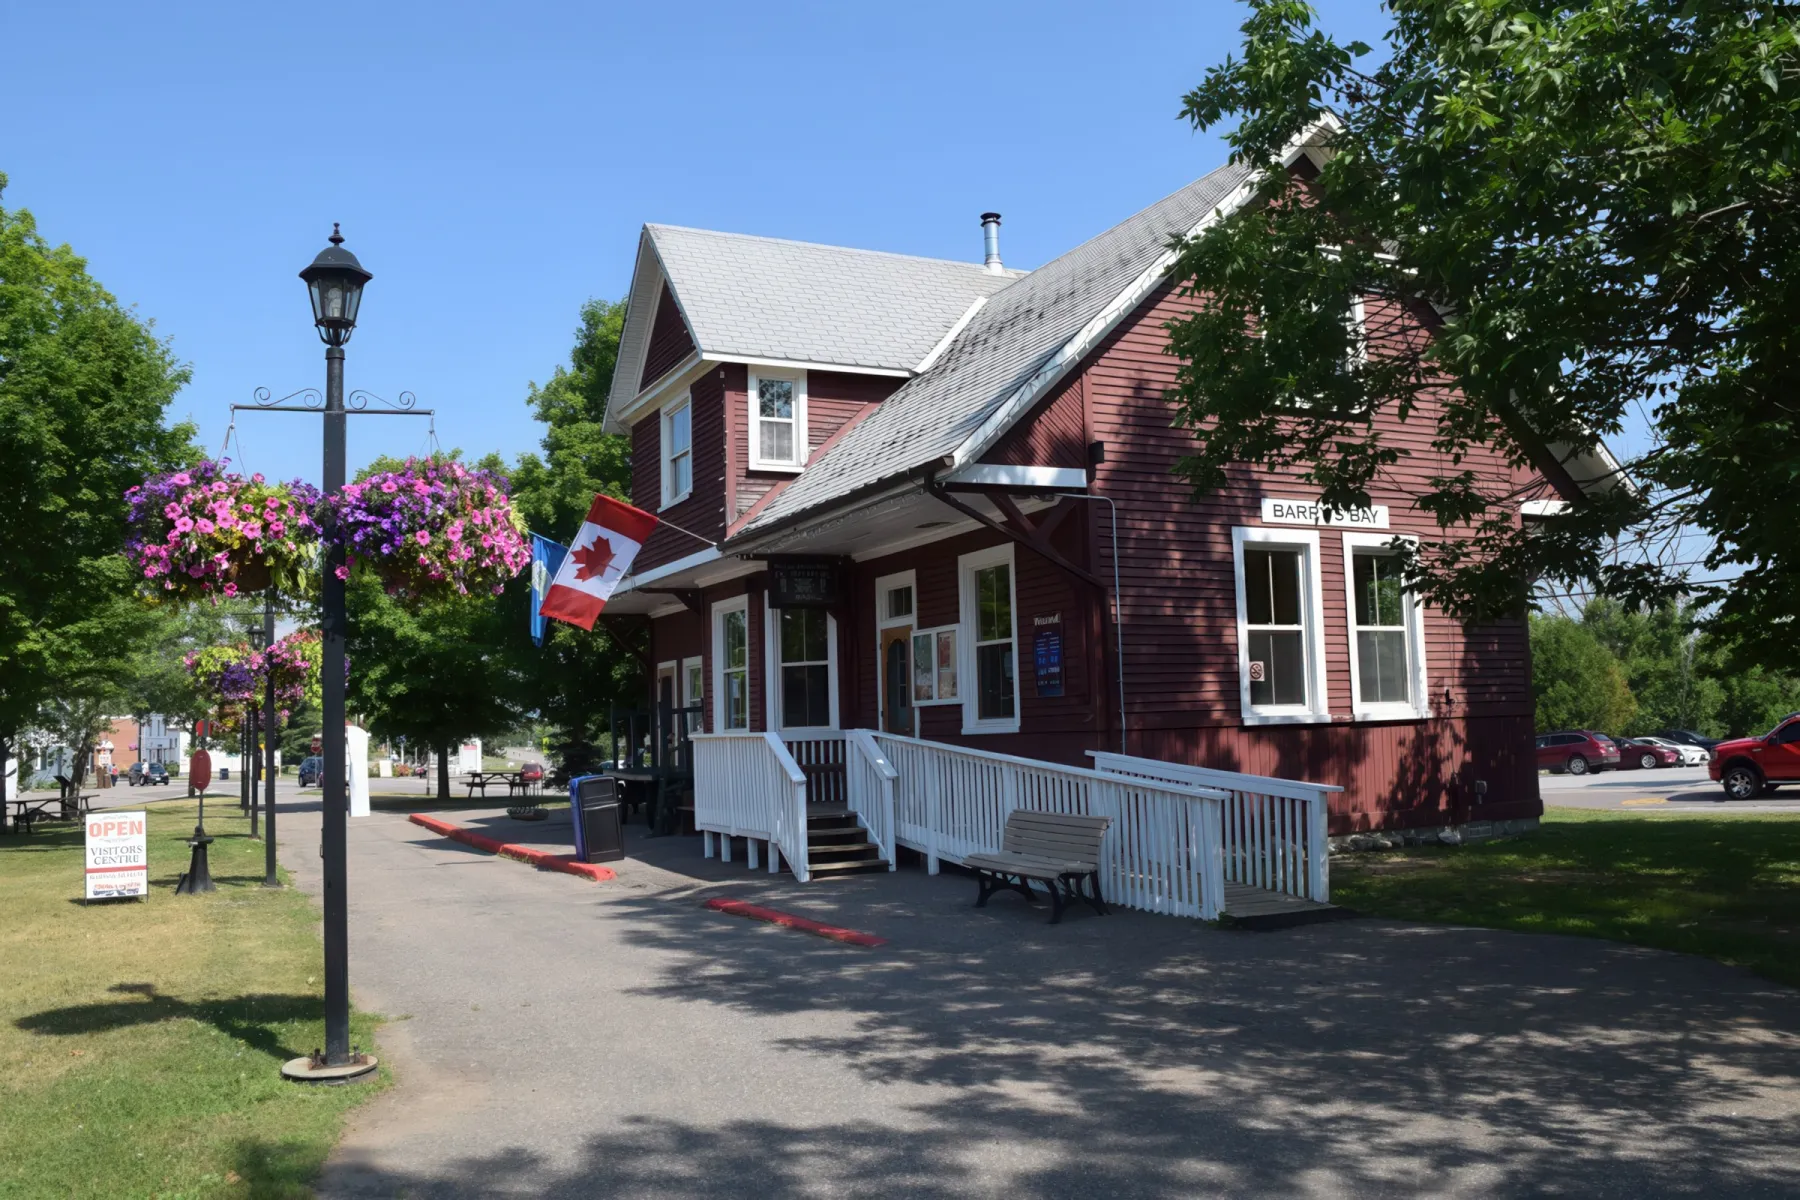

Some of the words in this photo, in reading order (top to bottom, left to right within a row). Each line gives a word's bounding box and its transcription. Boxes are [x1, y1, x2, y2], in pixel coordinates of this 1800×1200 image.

[1272, 503, 1345, 521] BARRS
[1350, 508, 1378, 523] BAY
[89, 820, 143, 837] OPEN
[90, 845, 144, 856] VISITORS
[93, 854, 139, 865] CENTRE
